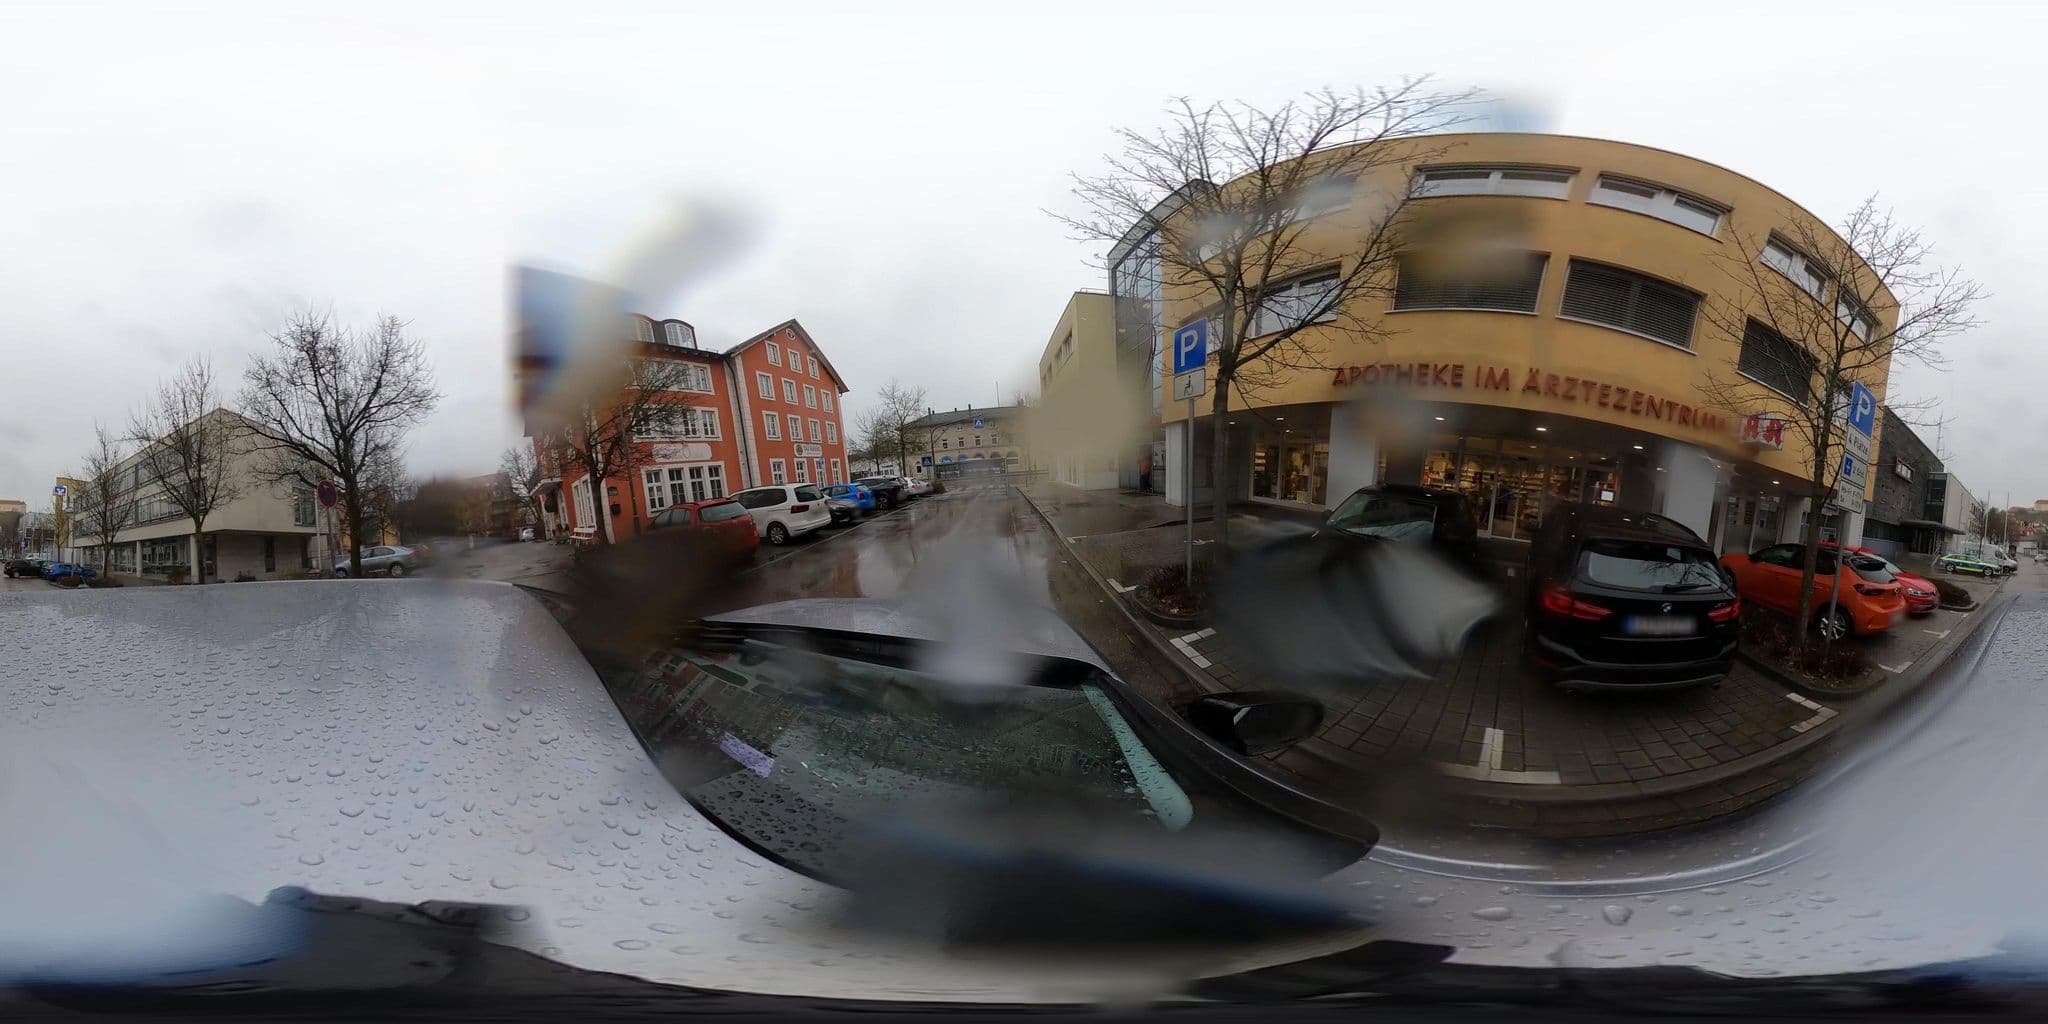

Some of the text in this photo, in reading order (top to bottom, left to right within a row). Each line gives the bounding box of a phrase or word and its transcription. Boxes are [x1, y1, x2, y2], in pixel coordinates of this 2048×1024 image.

[1180, 329, 1199, 367] P
[1333, 363, 1464, 388] APOTHEKE
[1475, 365, 1511, 391] IM
[1856, 390, 1871, 422] P
